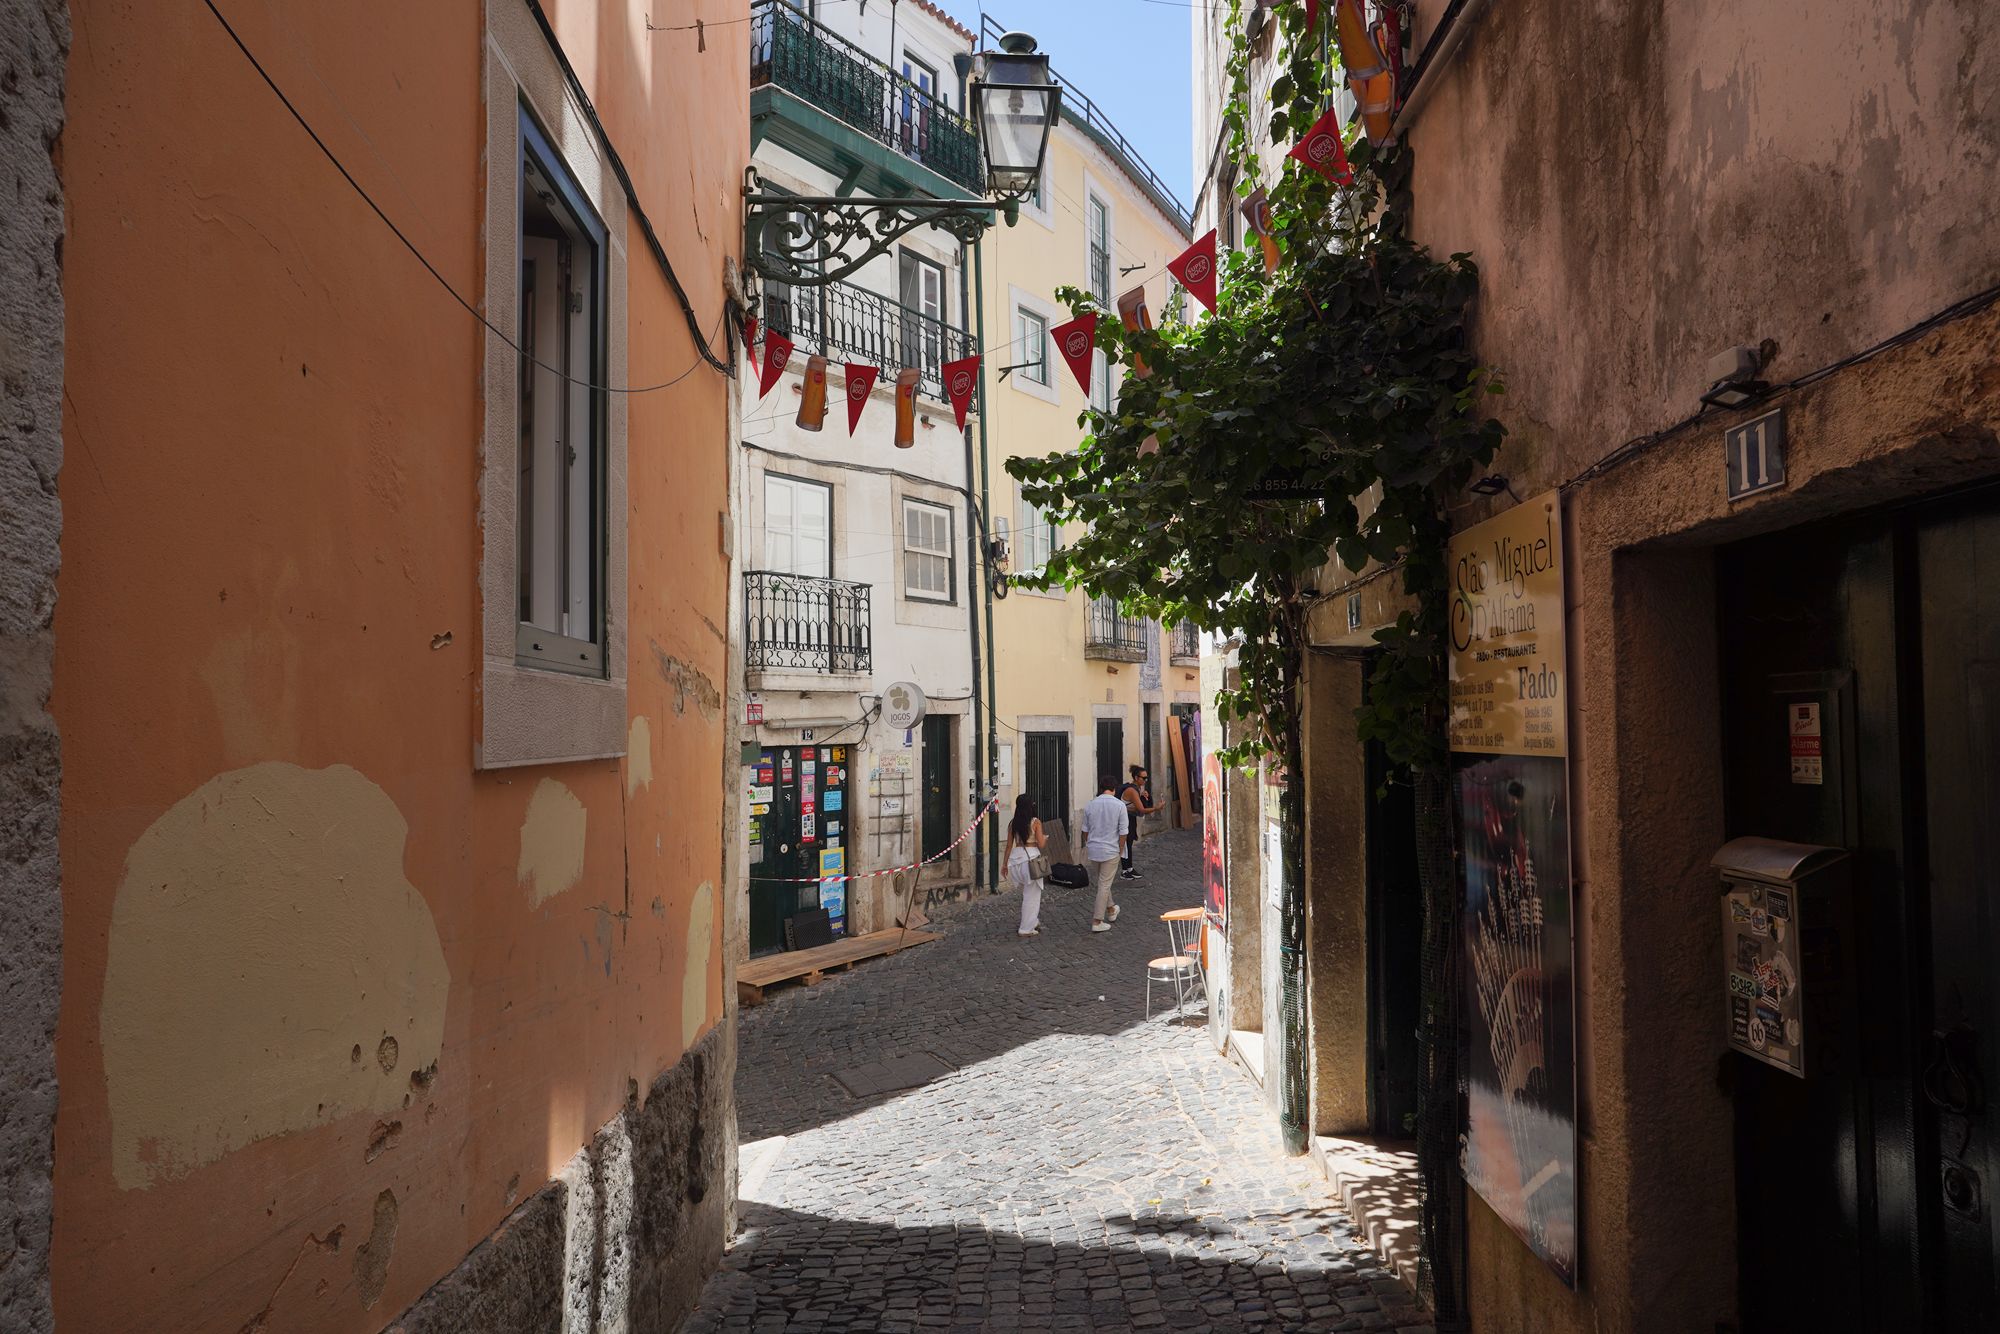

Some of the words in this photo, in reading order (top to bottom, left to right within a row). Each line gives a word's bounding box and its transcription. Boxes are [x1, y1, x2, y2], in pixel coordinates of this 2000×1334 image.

[1310, 137, 1331, 154] SUPER
[1315, 144, 1334, 159] BOCK
[1187, 258, 1206, 274] SUPER
[1190, 264, 1207, 279] BOCK
[1737, 422, 1769, 491] 11
[1265, 479, 1288, 491] 855
[1290, 479, 1307, 490] 44
[1311, 480, 1327, 490] 22
[1495, 514, 1554, 600] Miguel
[1475, 592, 1536, 641] D'Alfama
[1477, 651, 1490, 662] FADO
[1494, 643, 1536, 660] RESTAURANTE
[1518, 662, 1558, 700] Fado
[890, 712, 911, 724] JOGOS
[804, 729, 813, 741] 12
[1791, 738, 1821, 750] Alarme
